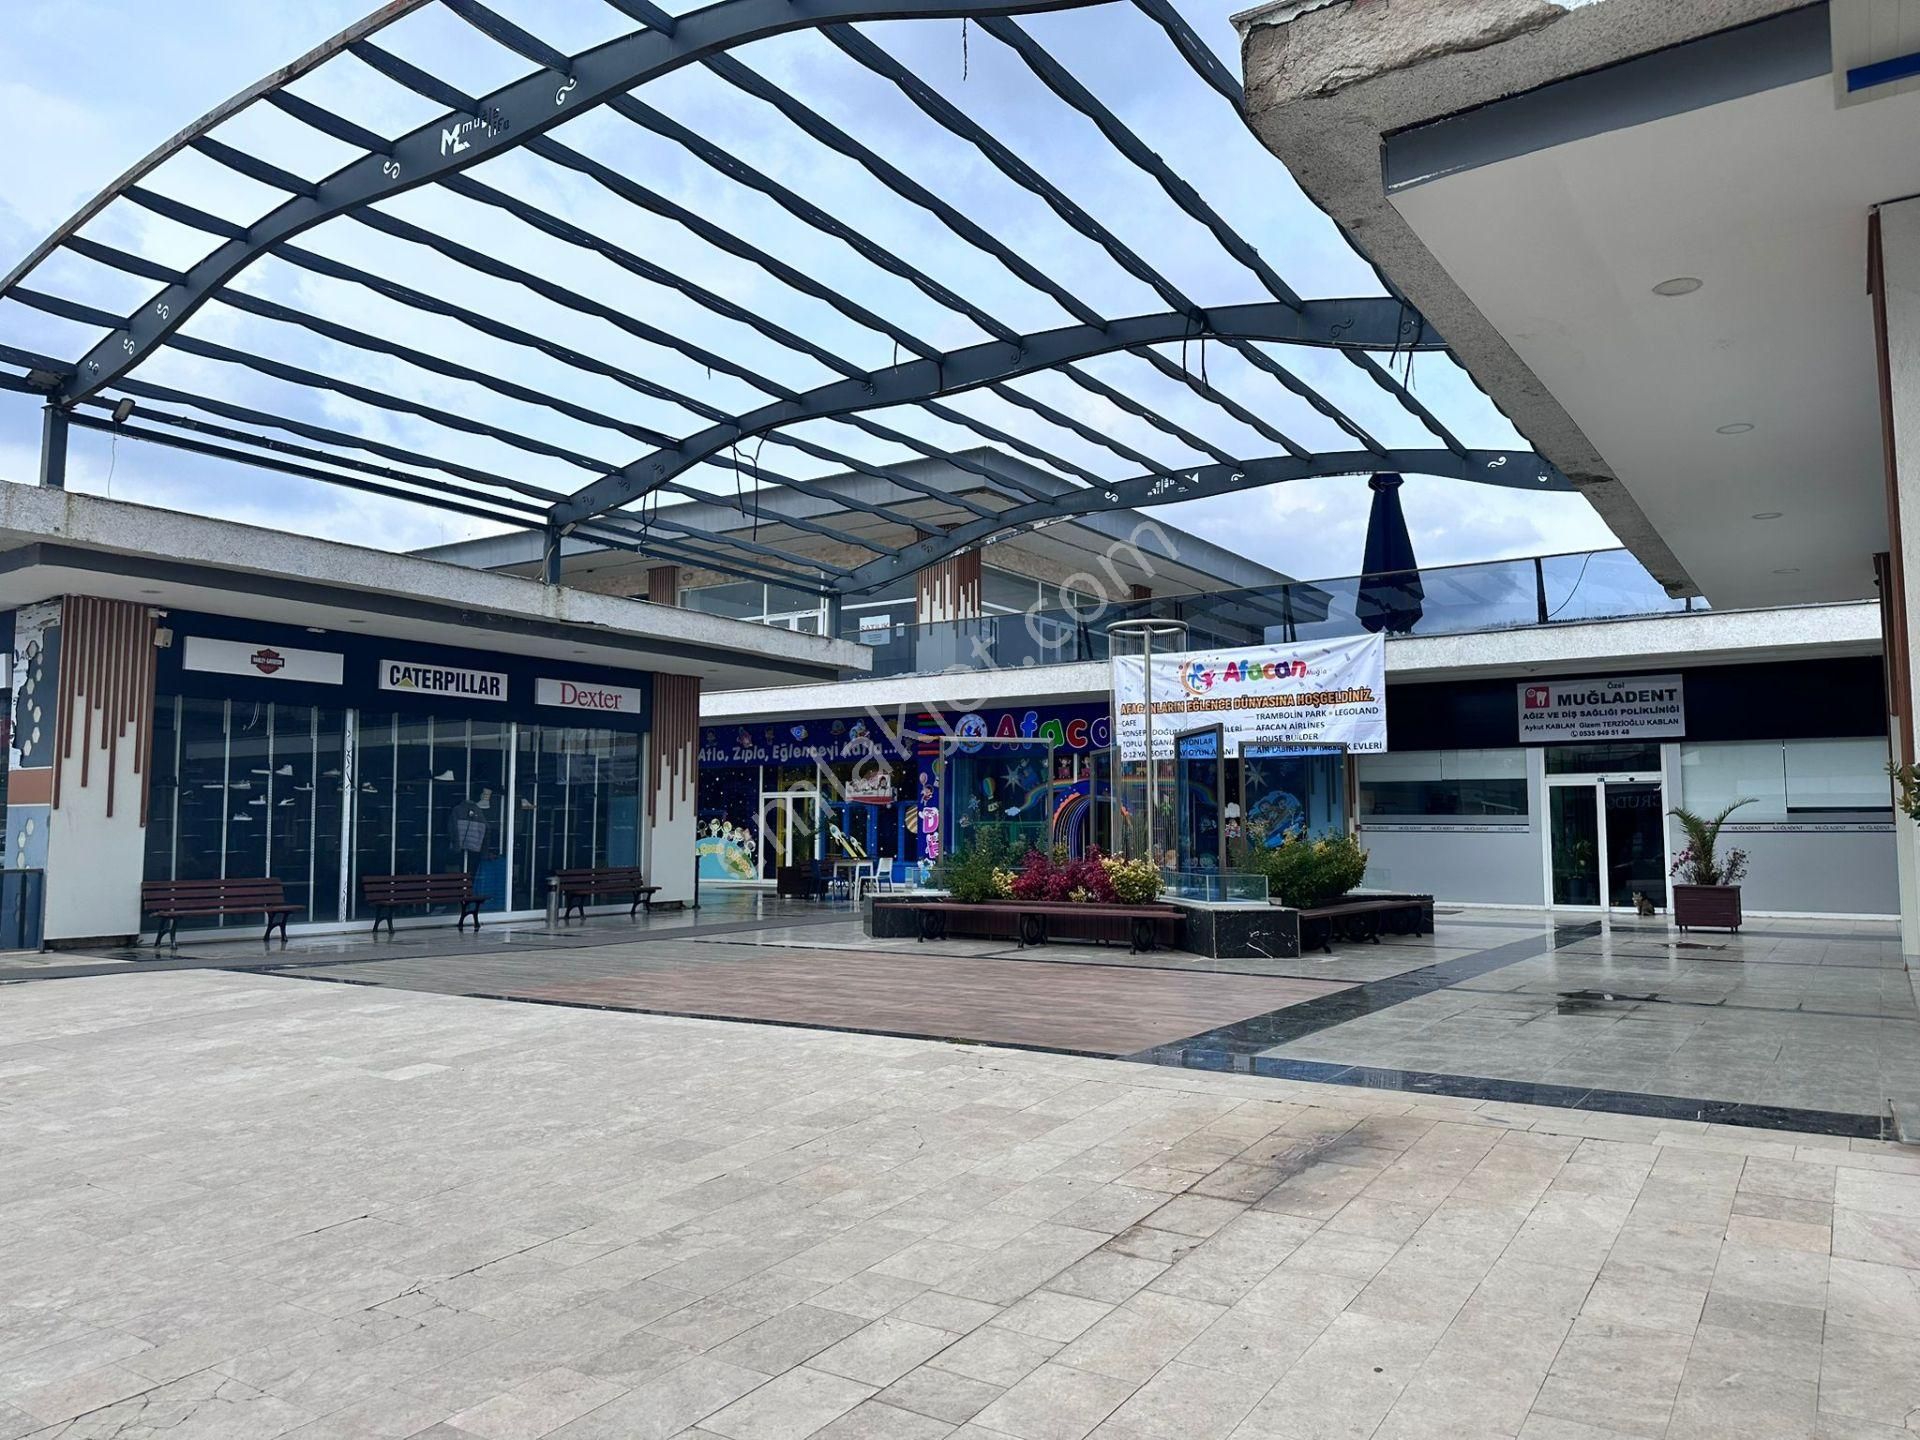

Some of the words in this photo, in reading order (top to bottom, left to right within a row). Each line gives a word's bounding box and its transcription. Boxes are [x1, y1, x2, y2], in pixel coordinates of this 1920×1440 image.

[1223, 659, 1306, 682] Afacan
[390, 665, 500, 696] CATERPILLAR
[560, 682, 622, 710] Dexter
[1121, 700, 1185, 715] AFACNLARIN
[1187, 697, 1232, 712] EĞLENCE
[1233, 694, 1295, 709] DÜNYASINA
[1557, 689, 1677, 707] MUĞLADENT
[1256, 709, 1302, 720] TRAMBOLİN
[1305, 710, 1327, 718] PARK
[1334, 707, 1379, 717] LEGOLAND
[1523, 712, 1545, 720] AĞIZ
[1562, 710, 1577, 719] DİŞ
[1580, 708, 1617, 717] SAĞLIĞI
[1256, 723, 1286, 731] AFACAN
[698, 747, 728, 762] Atla,
